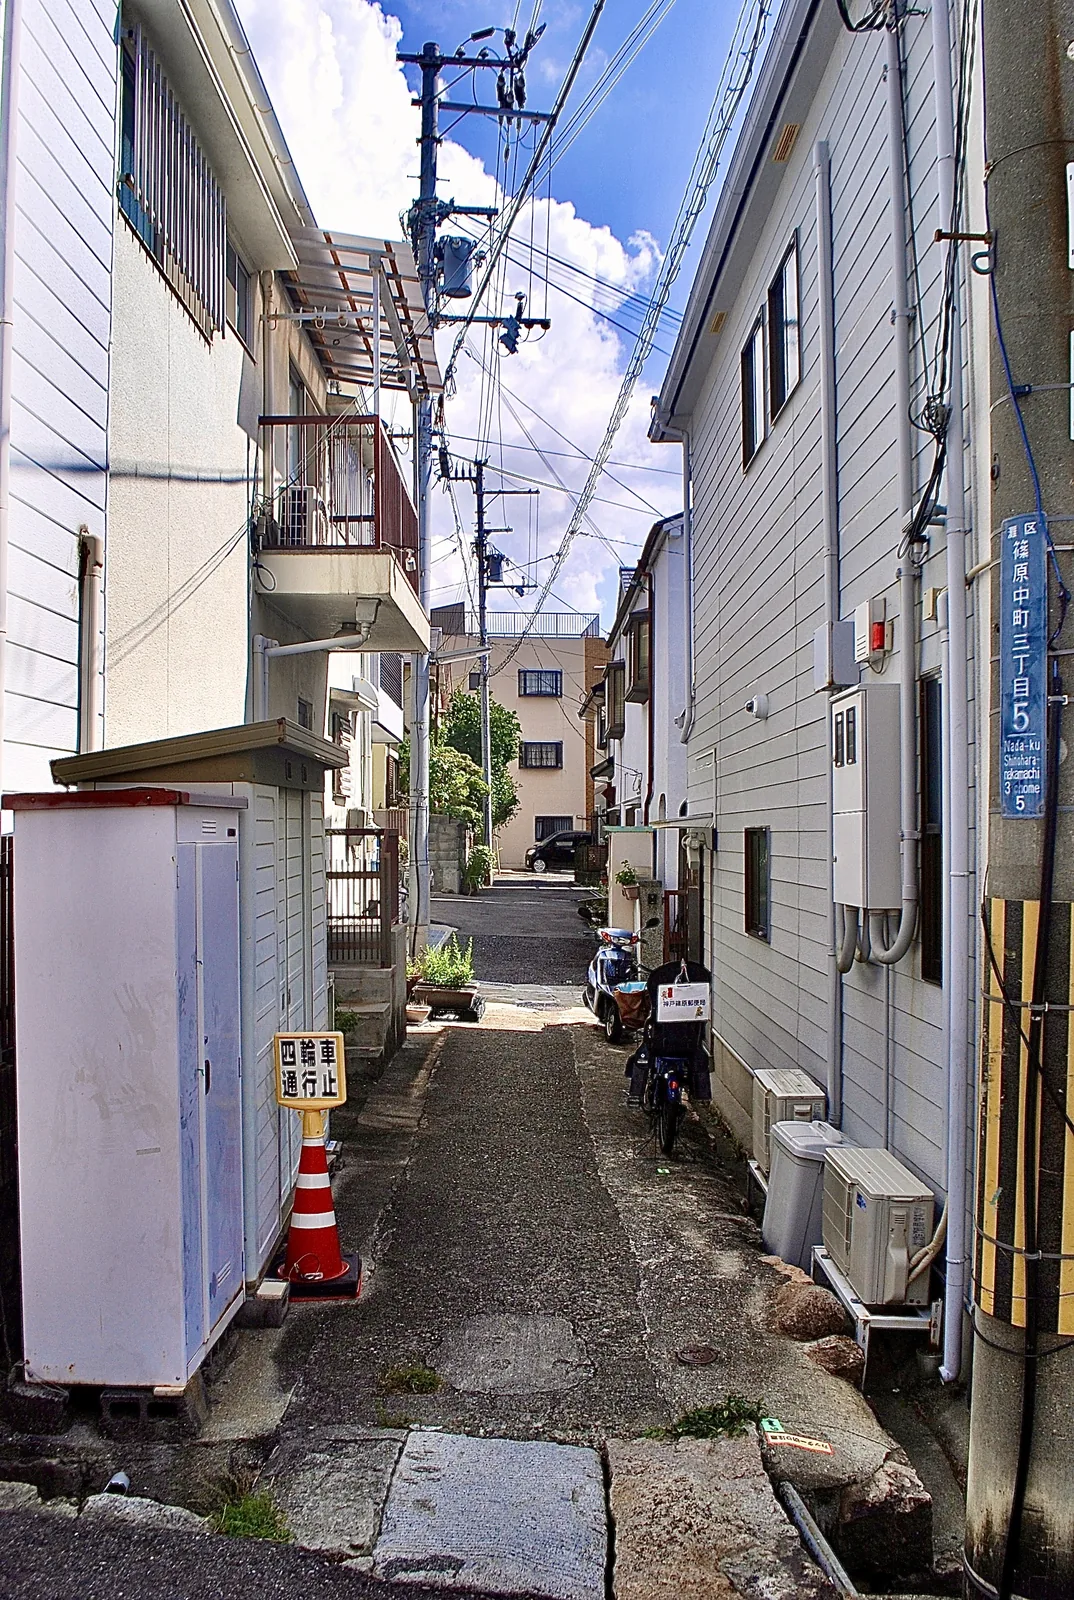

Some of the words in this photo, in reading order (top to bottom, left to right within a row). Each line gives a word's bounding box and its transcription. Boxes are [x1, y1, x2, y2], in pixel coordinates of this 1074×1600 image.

[1013, 703, 1029, 731] 5
[1004, 740, 1040, 752] Nada-ku
[1004, 767, 1040, 780] nakamachi
[1004, 782, 1011, 795] 3
[1013, 783, 1040, 794] chome
[1016, 795, 1025, 810] 5
[280, 1039, 336, 1067] 四輪車
[281, 1070, 337, 1097] 通行止
